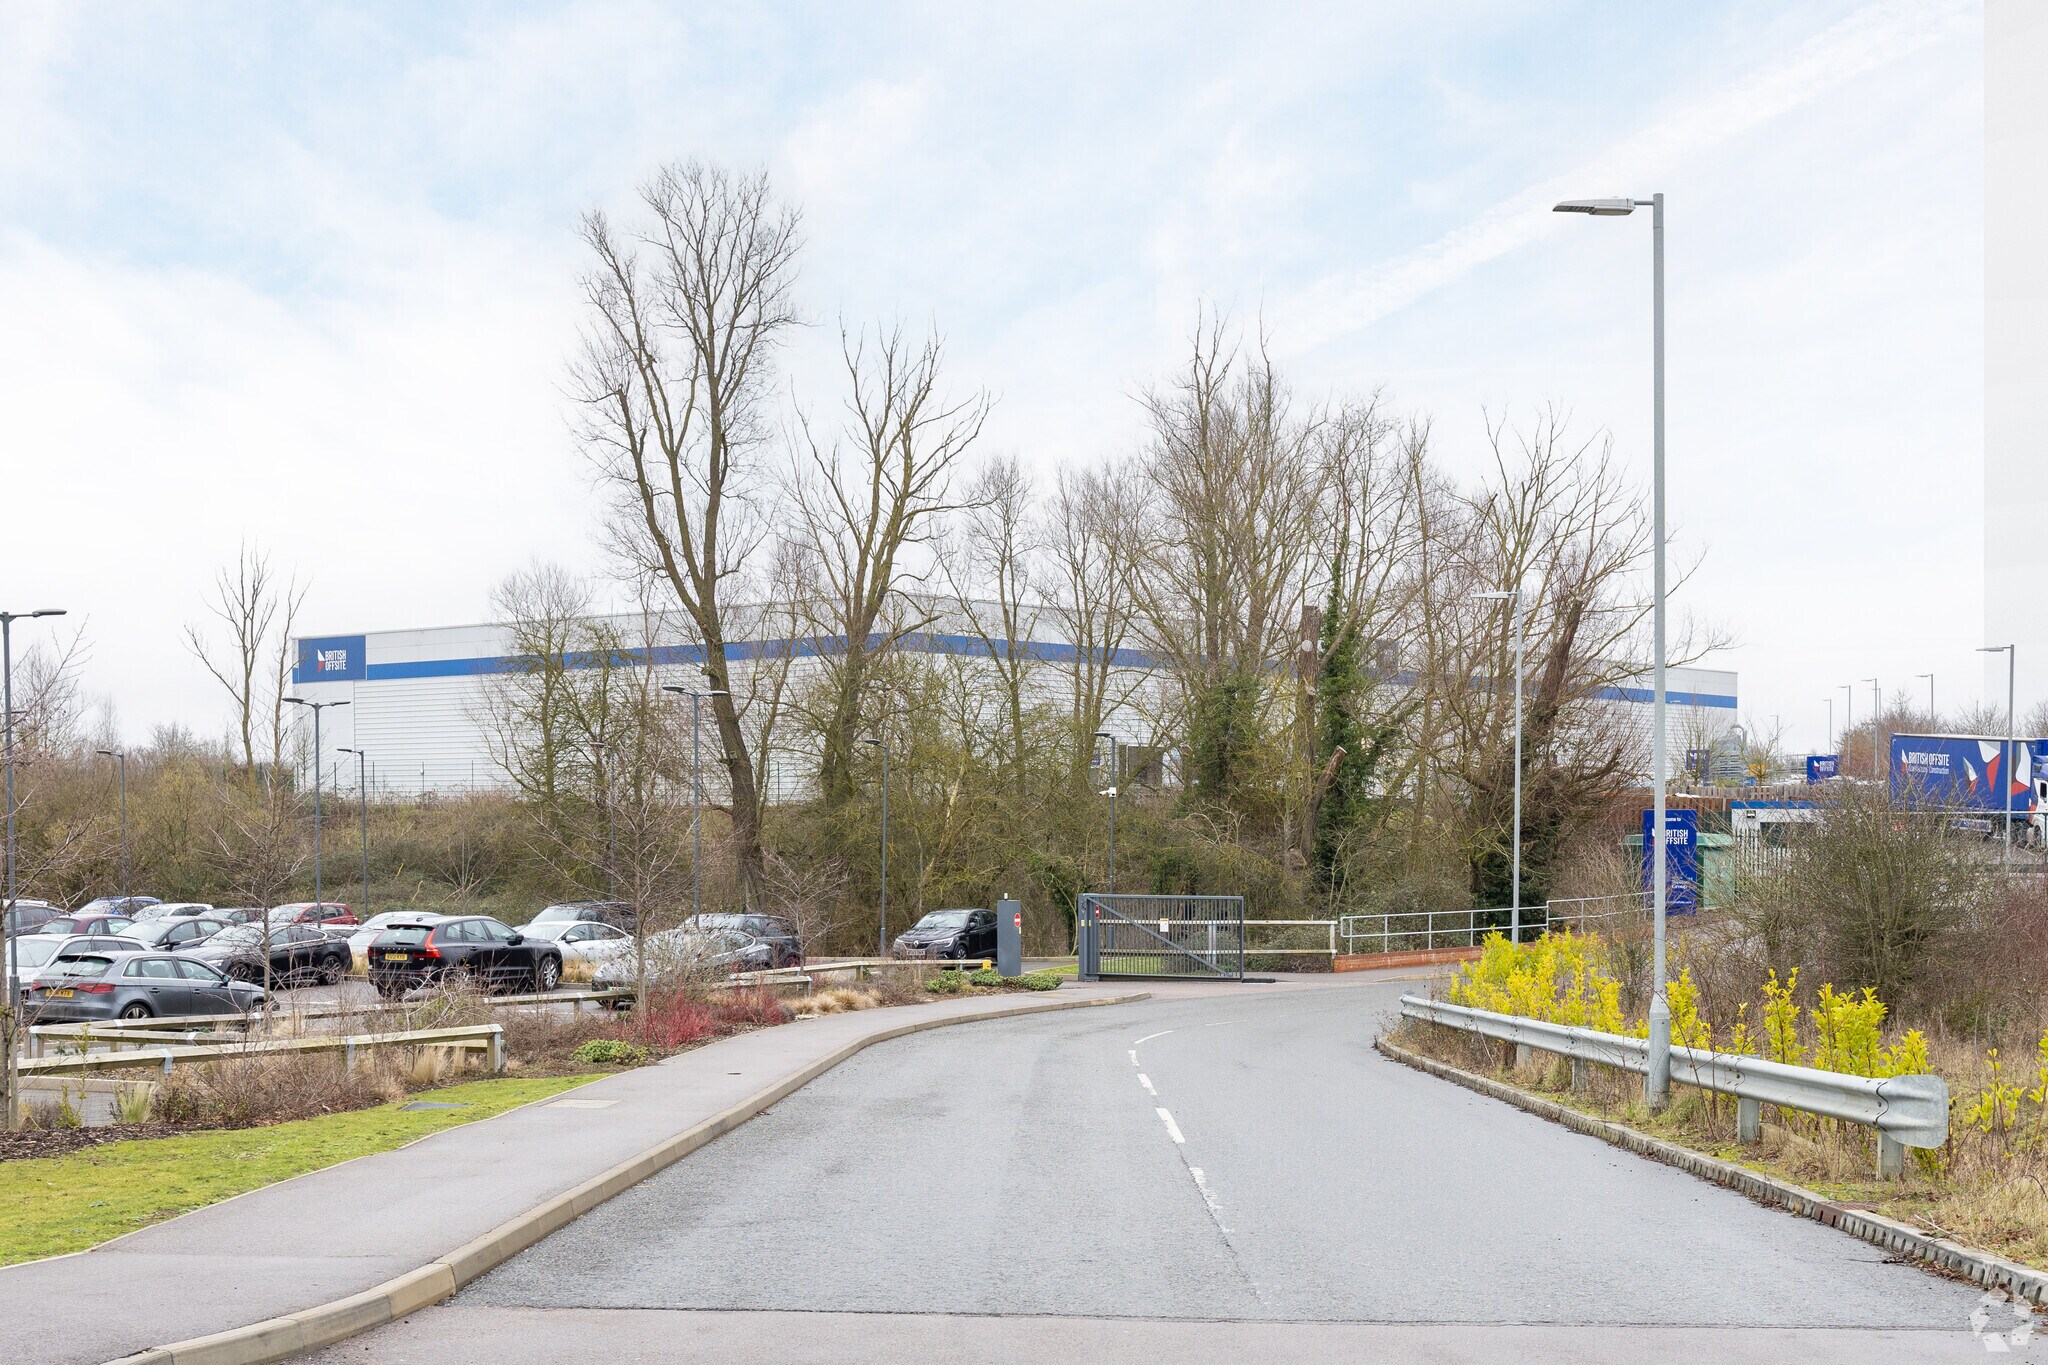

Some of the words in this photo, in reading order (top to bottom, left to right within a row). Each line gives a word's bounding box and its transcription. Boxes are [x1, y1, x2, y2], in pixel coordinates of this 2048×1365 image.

[325, 650, 346, 660] BRITISH
[325, 660, 346, 671] OFFSITE
[1908, 752, 1928, 765] BRITISH
[1929, 753, 1950, 766] OFFSITE
[1666, 829, 1688, 837] RITISH
[1666, 837, 1688, 845] FFSITE
